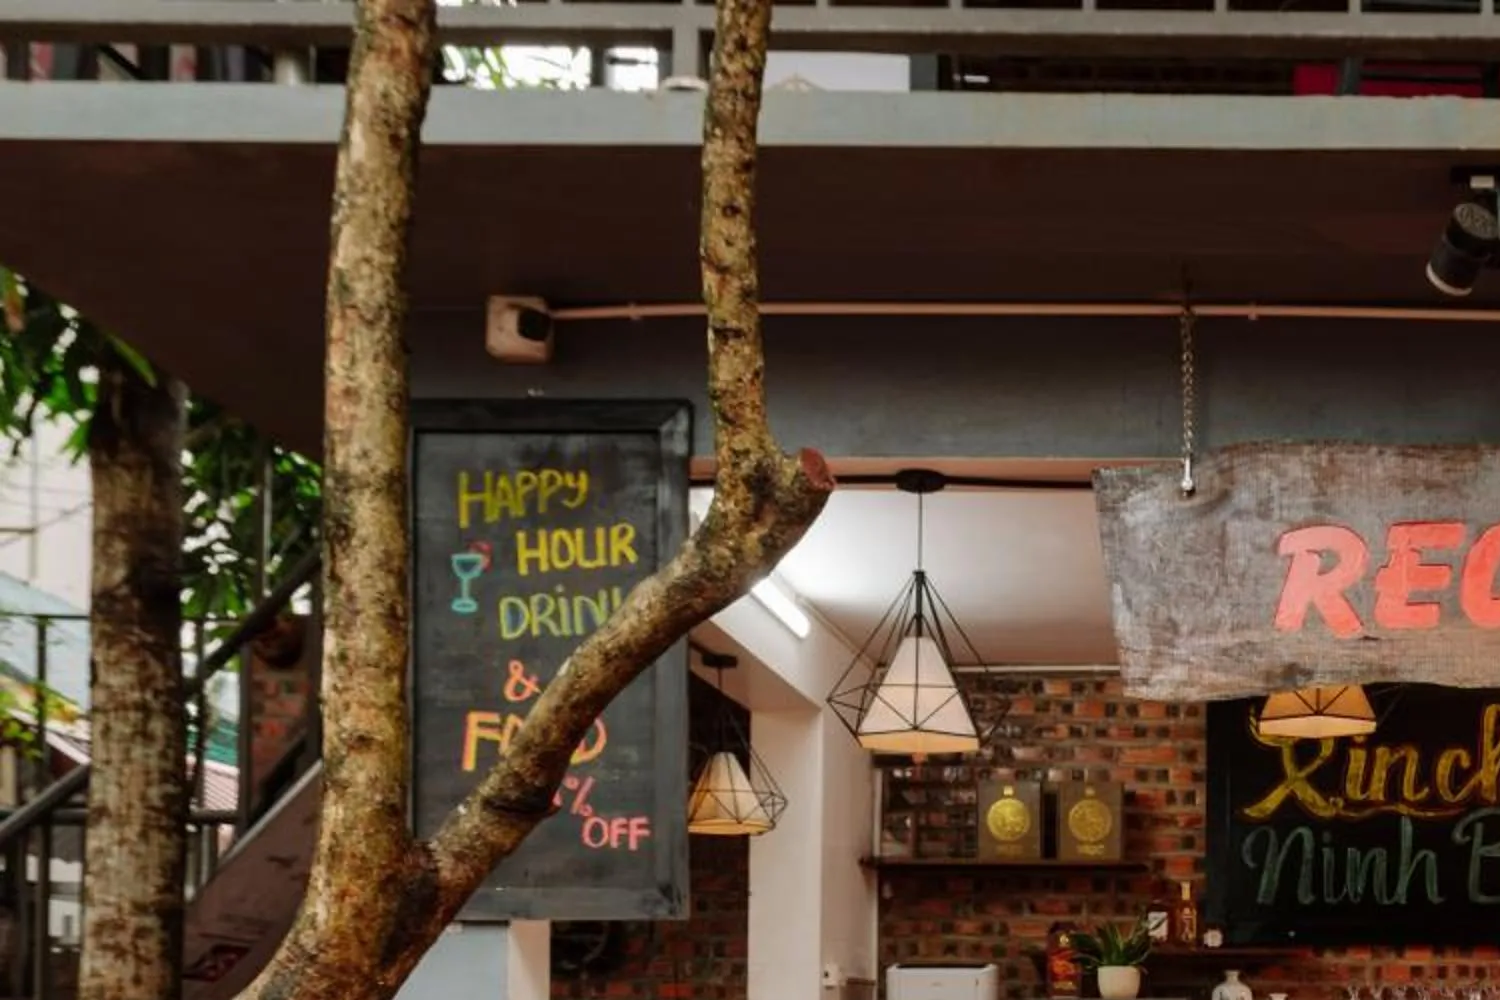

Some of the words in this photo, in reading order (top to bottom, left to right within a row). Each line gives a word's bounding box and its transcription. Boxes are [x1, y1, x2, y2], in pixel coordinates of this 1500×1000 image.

[516, 523, 638, 576] HOUR
[503, 659, 541, 702] &
[582, 816, 650, 850] OFF
[1242, 812, 1446, 907] Ninh
